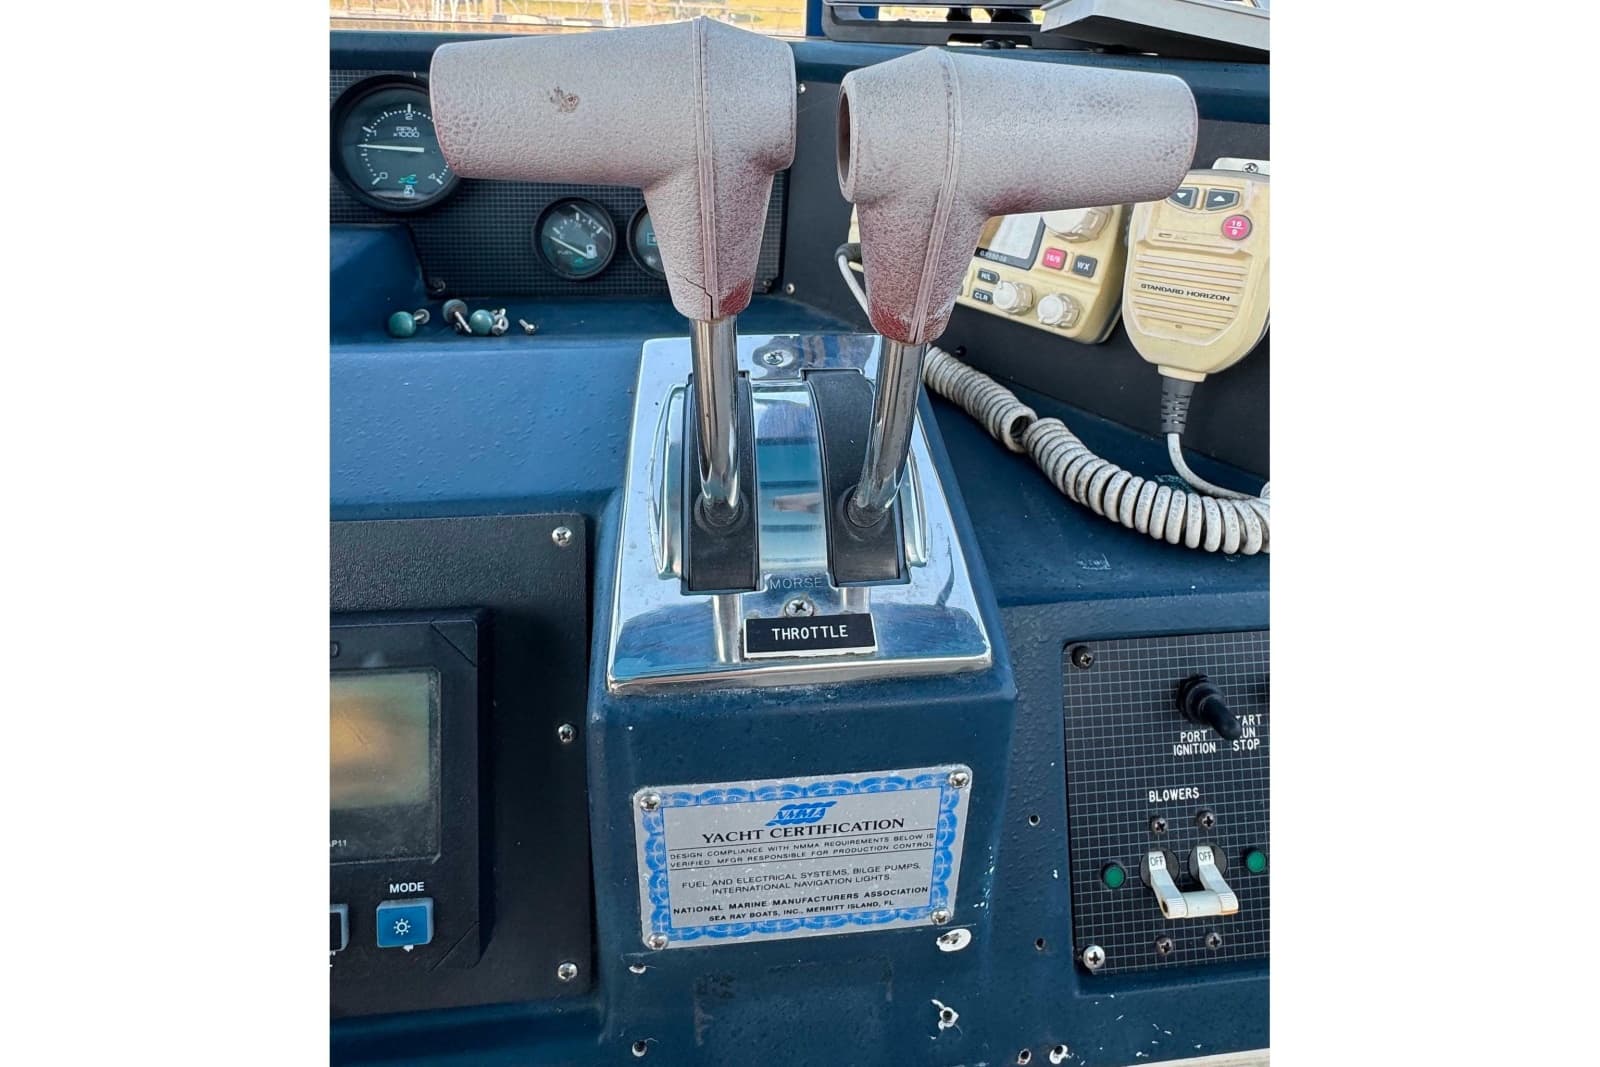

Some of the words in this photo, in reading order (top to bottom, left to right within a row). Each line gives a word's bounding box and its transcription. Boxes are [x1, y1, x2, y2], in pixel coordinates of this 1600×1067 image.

[1077, 261, 1090, 271] WX
[974, 293, 988, 301] CLR
[1140, 283, 1184, 295] STANDARD
[1186, 290, 1230, 302] HORIZON
[770, 577, 824, 590] MORSE
[772, 625, 848, 640] THROTTLE
[1235, 714, 1262, 726] ART
[1180, 730, 1208, 743] PORT
[1240, 727, 1256, 738] UN
[1174, 742, 1216, 756] IGNITION
[1232, 738, 1260, 752] STOP
[1148, 787, 1200, 802] BLOWERS
[702, 830, 764, 844] YACHT
[770, 818, 904, 838] CERTIFICATION
[670, 852, 702, 860] DESIGN
[707, 847, 762, 856] COMPLIANCE
[824, 837, 889, 848] REQUIREMENTS
[748, 852, 806, 862] RESPONSIBLE
[833, 844, 888, 854] PRODUCTION
[894, 842, 933, 850] CONTROL
[1150, 856, 1164, 866] OFF
[1199, 852, 1212, 861] OFF
[682, 880, 706, 888] FUEL
[712, 878, 733, 886] AND
[736, 874, 797, 884] ELECTRICAL
[853, 866, 880, 874] BILGE
[390, 882, 424, 893] MODE
[712, 883, 790, 895] INTERNATIONAL
[794, 878, 852, 888] NAVIGATION
[674, 904, 723, 914] NATIONAL
[729, 900, 767, 910] MARINE
[772, 892, 858, 906] MANUFACTURERS
[864, 886, 928, 898] ASSOCIATION
[806, 904, 844, 913] MERRITT
